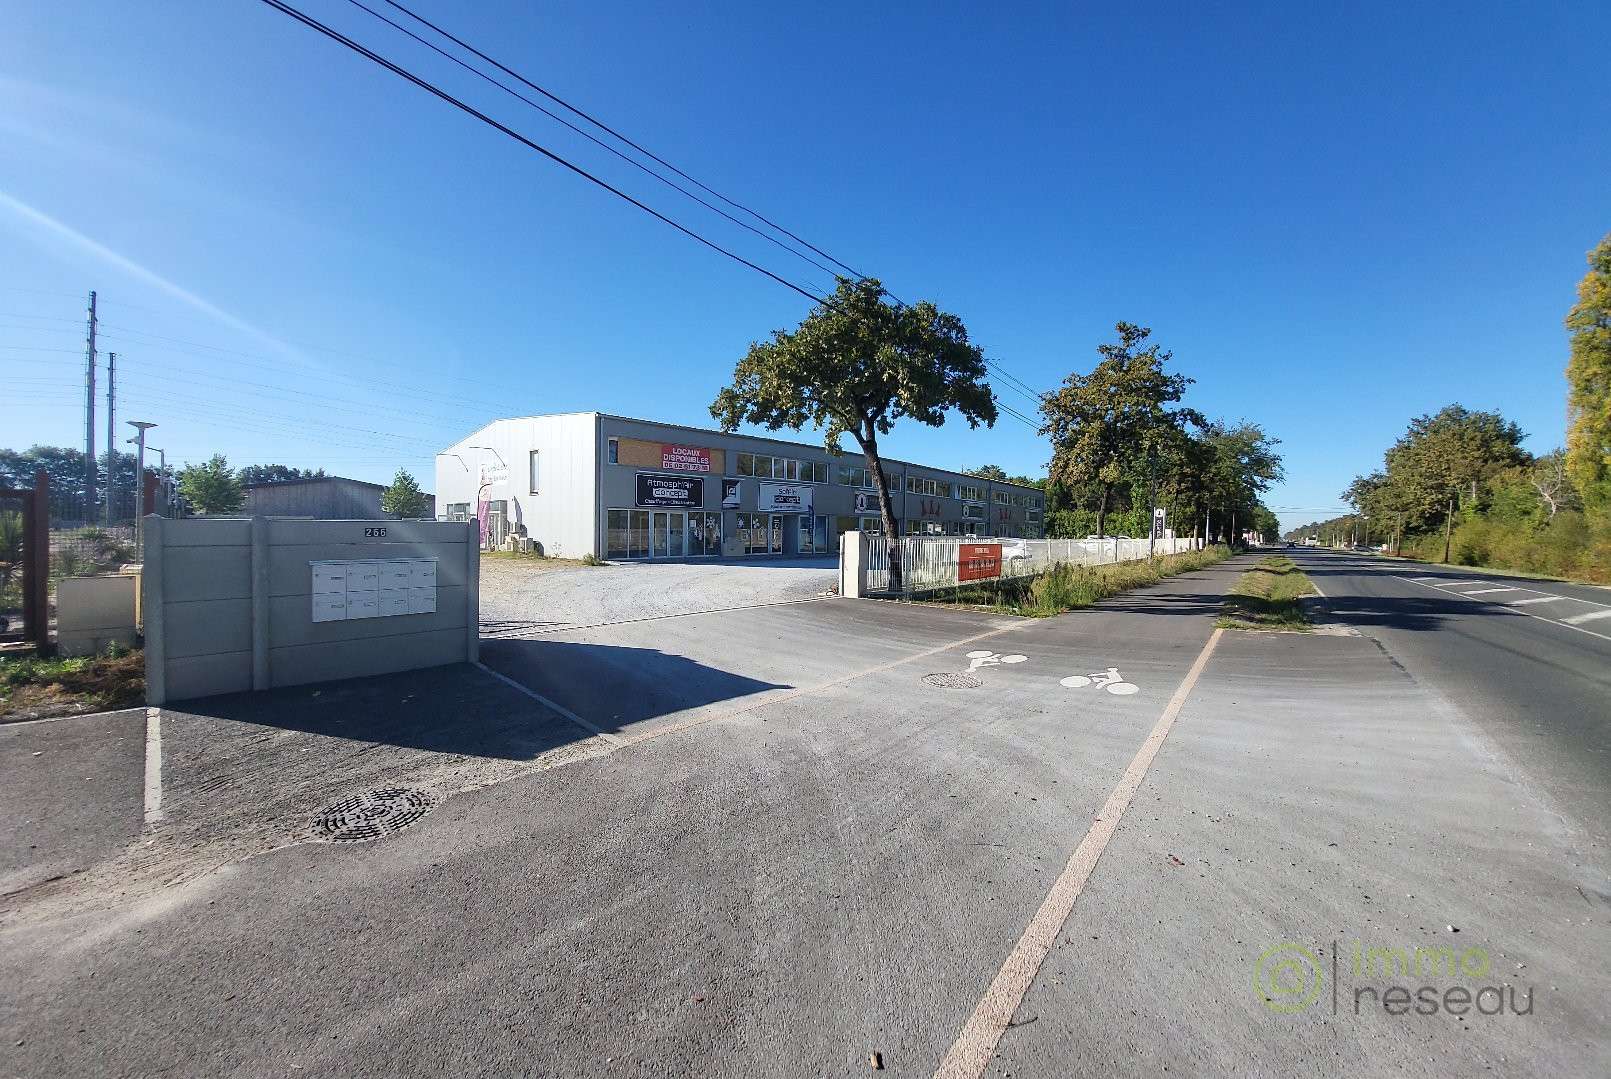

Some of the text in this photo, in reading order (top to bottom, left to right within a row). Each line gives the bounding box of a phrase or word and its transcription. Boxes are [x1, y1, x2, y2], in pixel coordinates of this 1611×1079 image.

[672, 447, 701, 457] LOCAUX
[663, 453, 709, 465] DISPONIBLES
[365, 528, 386, 537] 266
